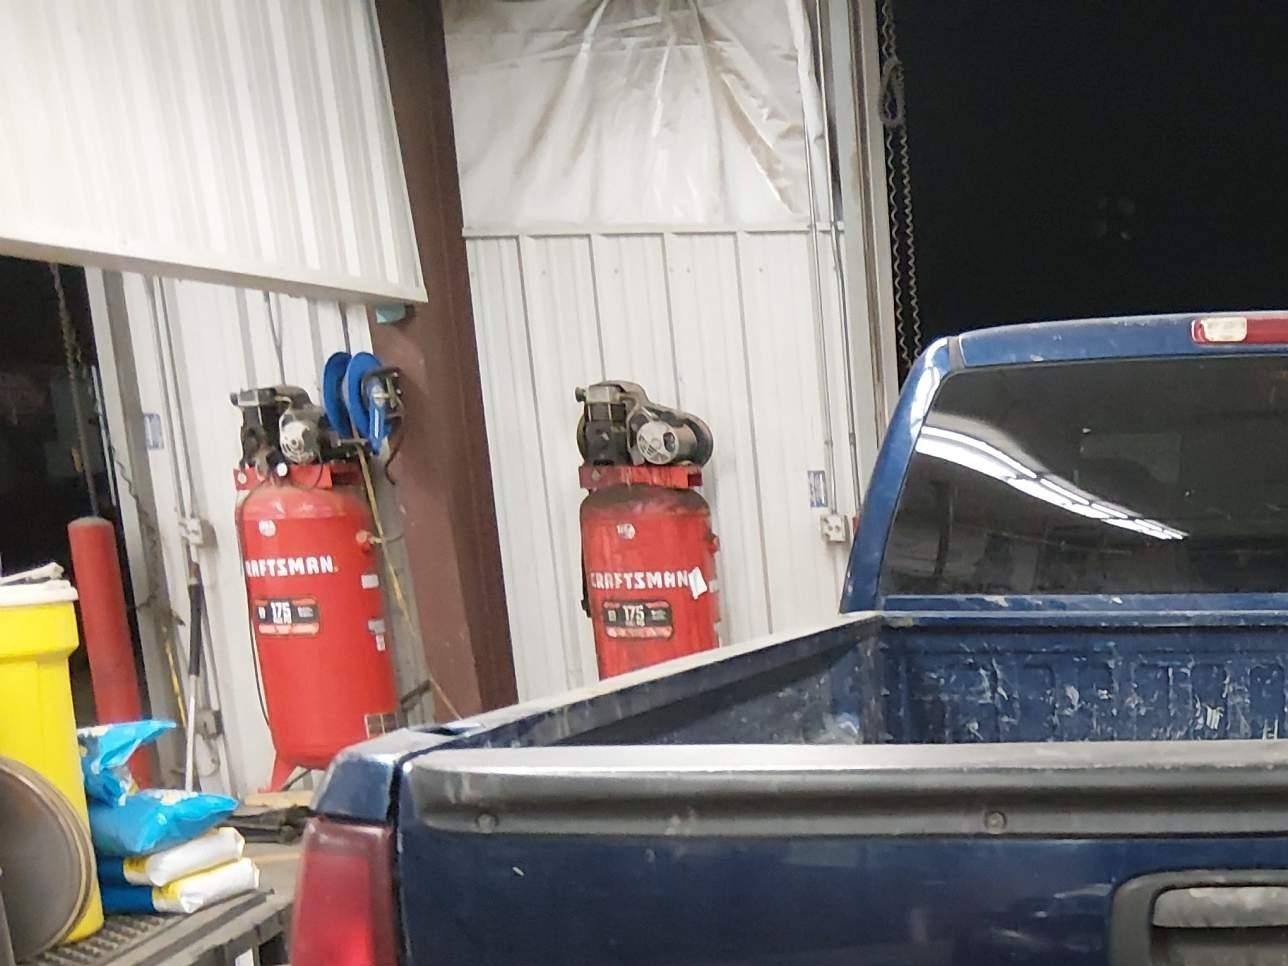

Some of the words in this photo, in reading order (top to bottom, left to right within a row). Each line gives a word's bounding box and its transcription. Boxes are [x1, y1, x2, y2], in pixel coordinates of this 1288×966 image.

[245, 554, 334, 577] RAFTSMAN
[590, 570, 689, 590] CRAFTSMAN
[270, 601, 292, 619] 175
[622, 604, 645, 621] 175
